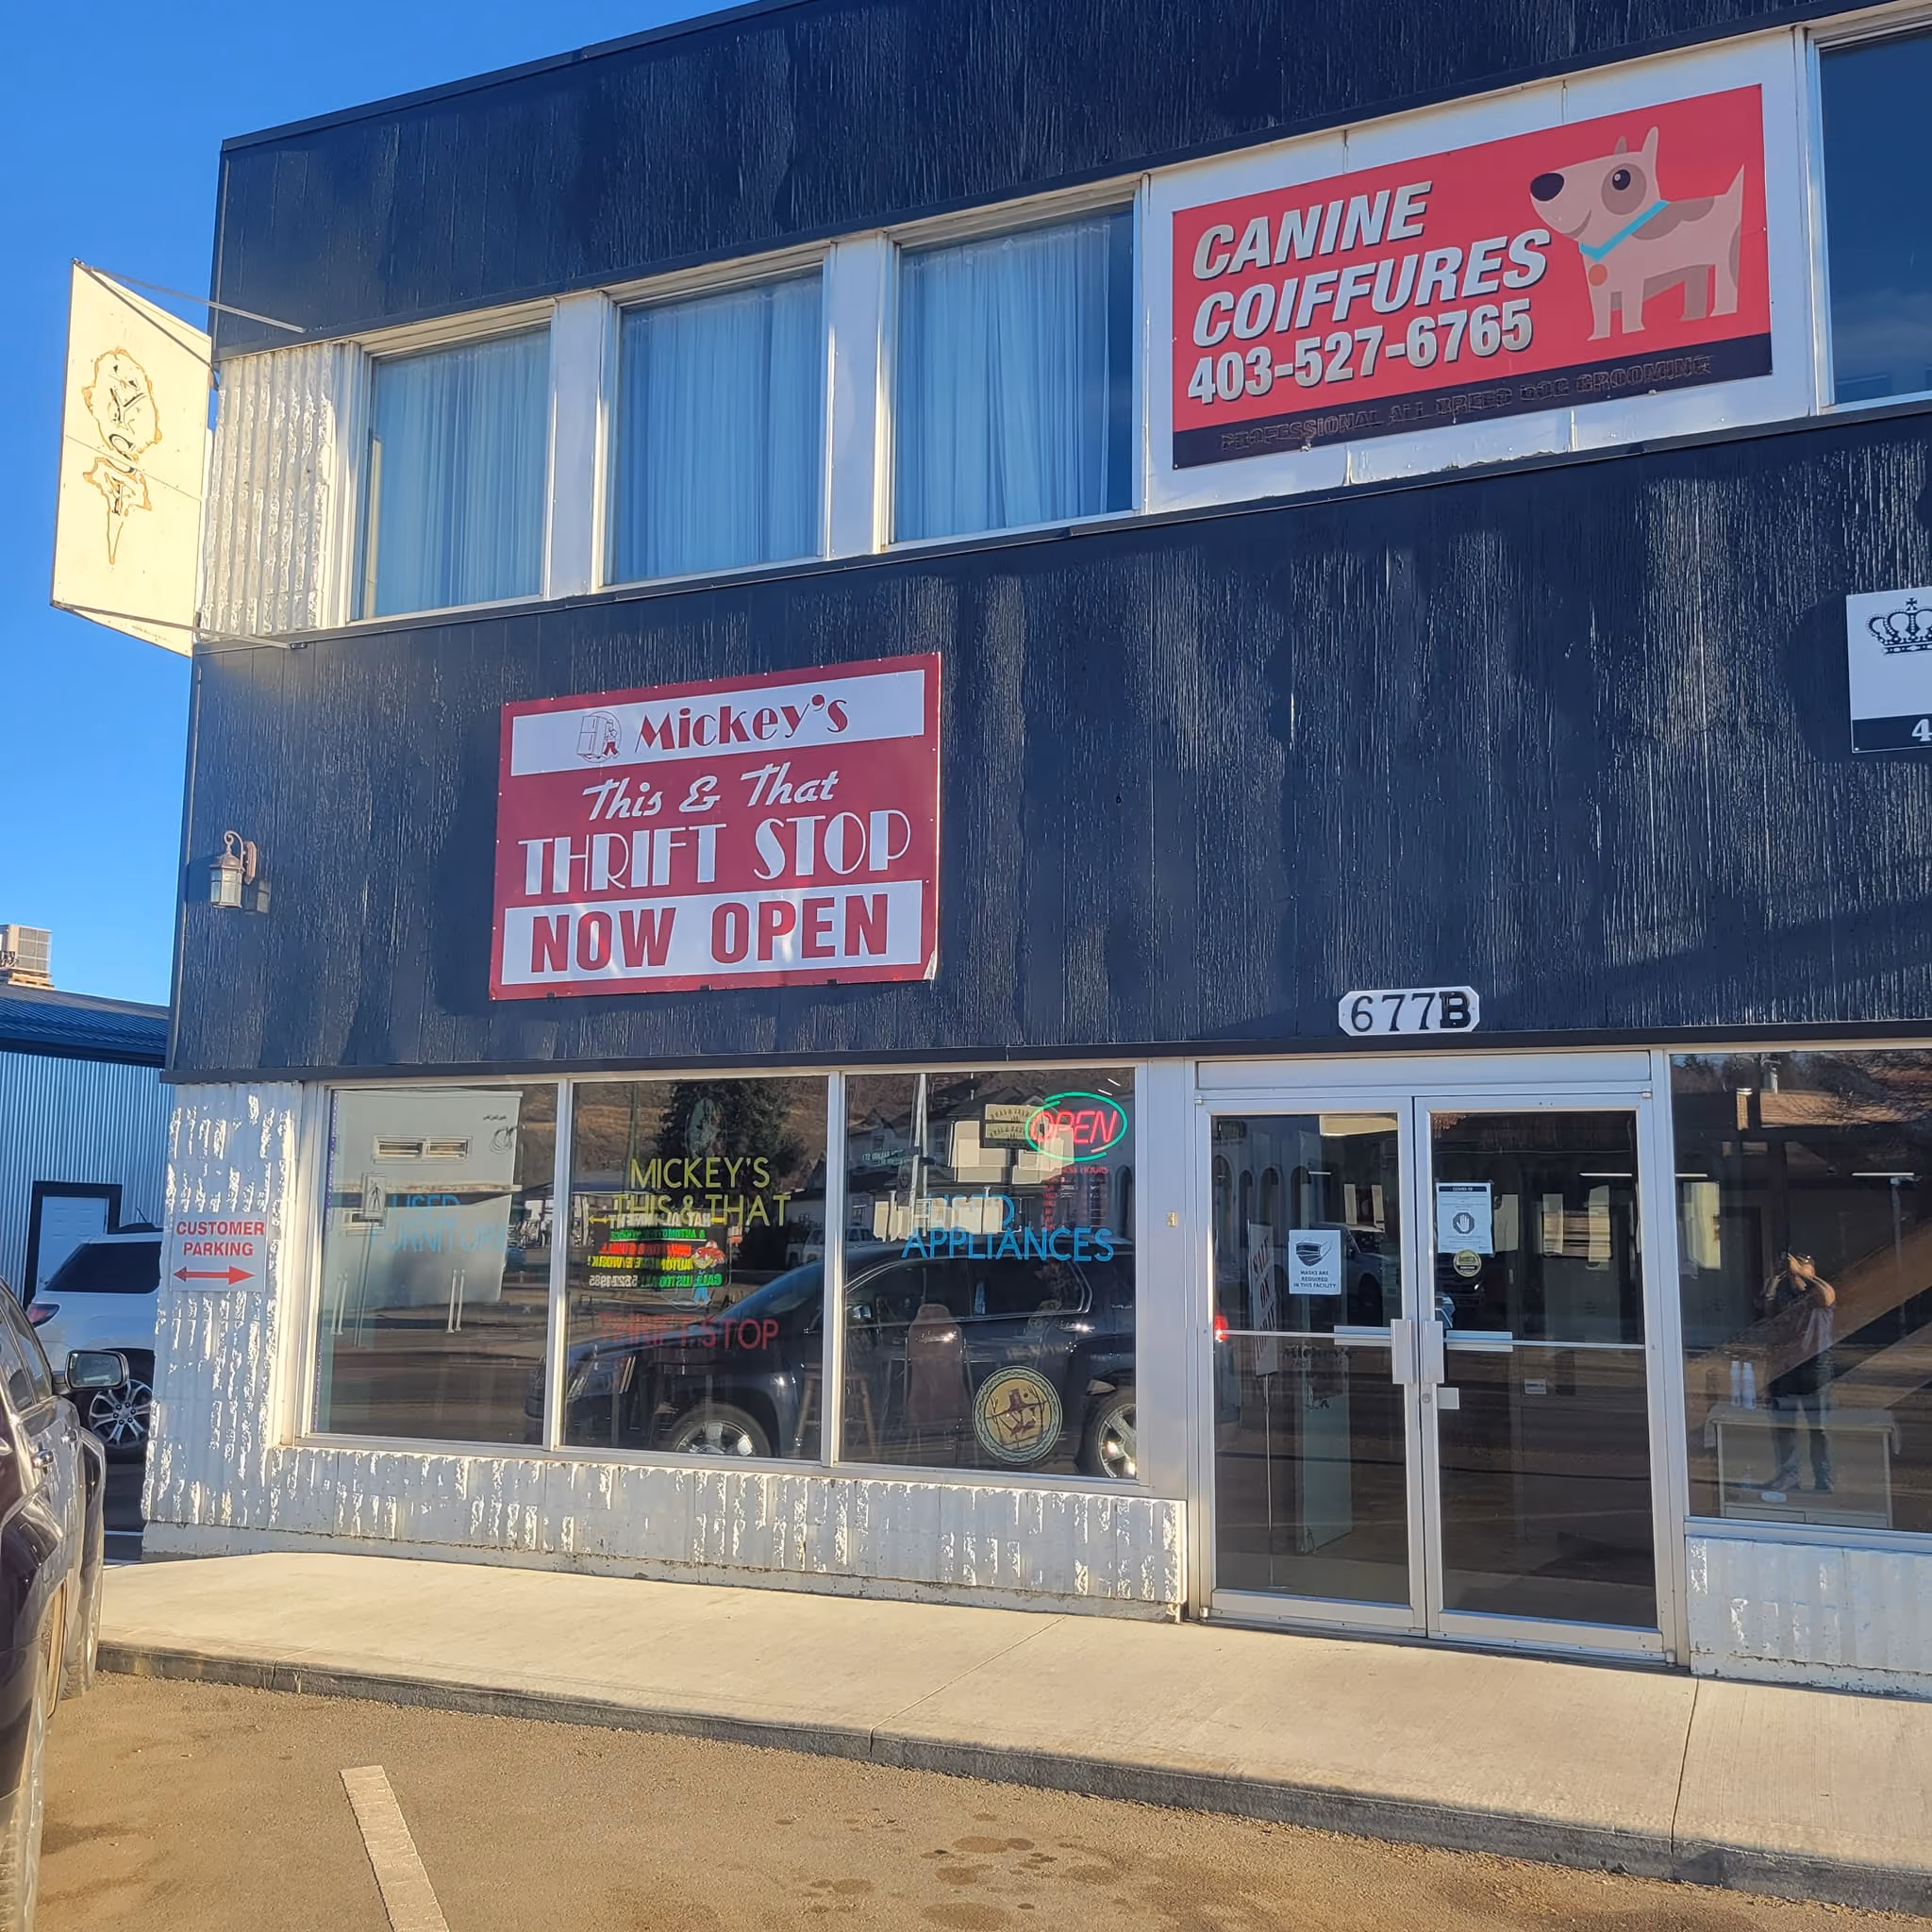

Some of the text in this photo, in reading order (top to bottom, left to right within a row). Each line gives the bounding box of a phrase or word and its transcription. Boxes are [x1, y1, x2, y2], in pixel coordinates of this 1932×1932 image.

[1192, 180, 1432, 281] CANINE
[1192, 228, 1551, 348] COIFFURES
[1188, 298, 1533, 405] 403-527-6765
[1221, 409, 1384, 452] PROFESSIONAL
[1436, 387, 1513, 416] BREED
[1576, 355, 1712, 392] GROOMING
[635, 693, 849, 754] Mickey's
[582, 761, 840, 821] This & That
[518, 808, 911, 896] THRIFT STOP
[530, 892, 889, 974] NOW OPEN
[1351, 991, 1472, 1033] 677B
[1030, 1109, 1118, 1144] OPEN
[629, 1157, 772, 1190] MICKEY'S
[175, 1221, 265, 1236] CUSTOMER
[614, 1192, 673, 1225] THIS
[678, 1193, 696, 1224] &
[705, 1193, 791, 1226] THAT
[183, 1241, 254, 1257] PARKING
[901, 1226, 1115, 1262] APPLIANCES
[702, 1317, 780, 1351] STOP
